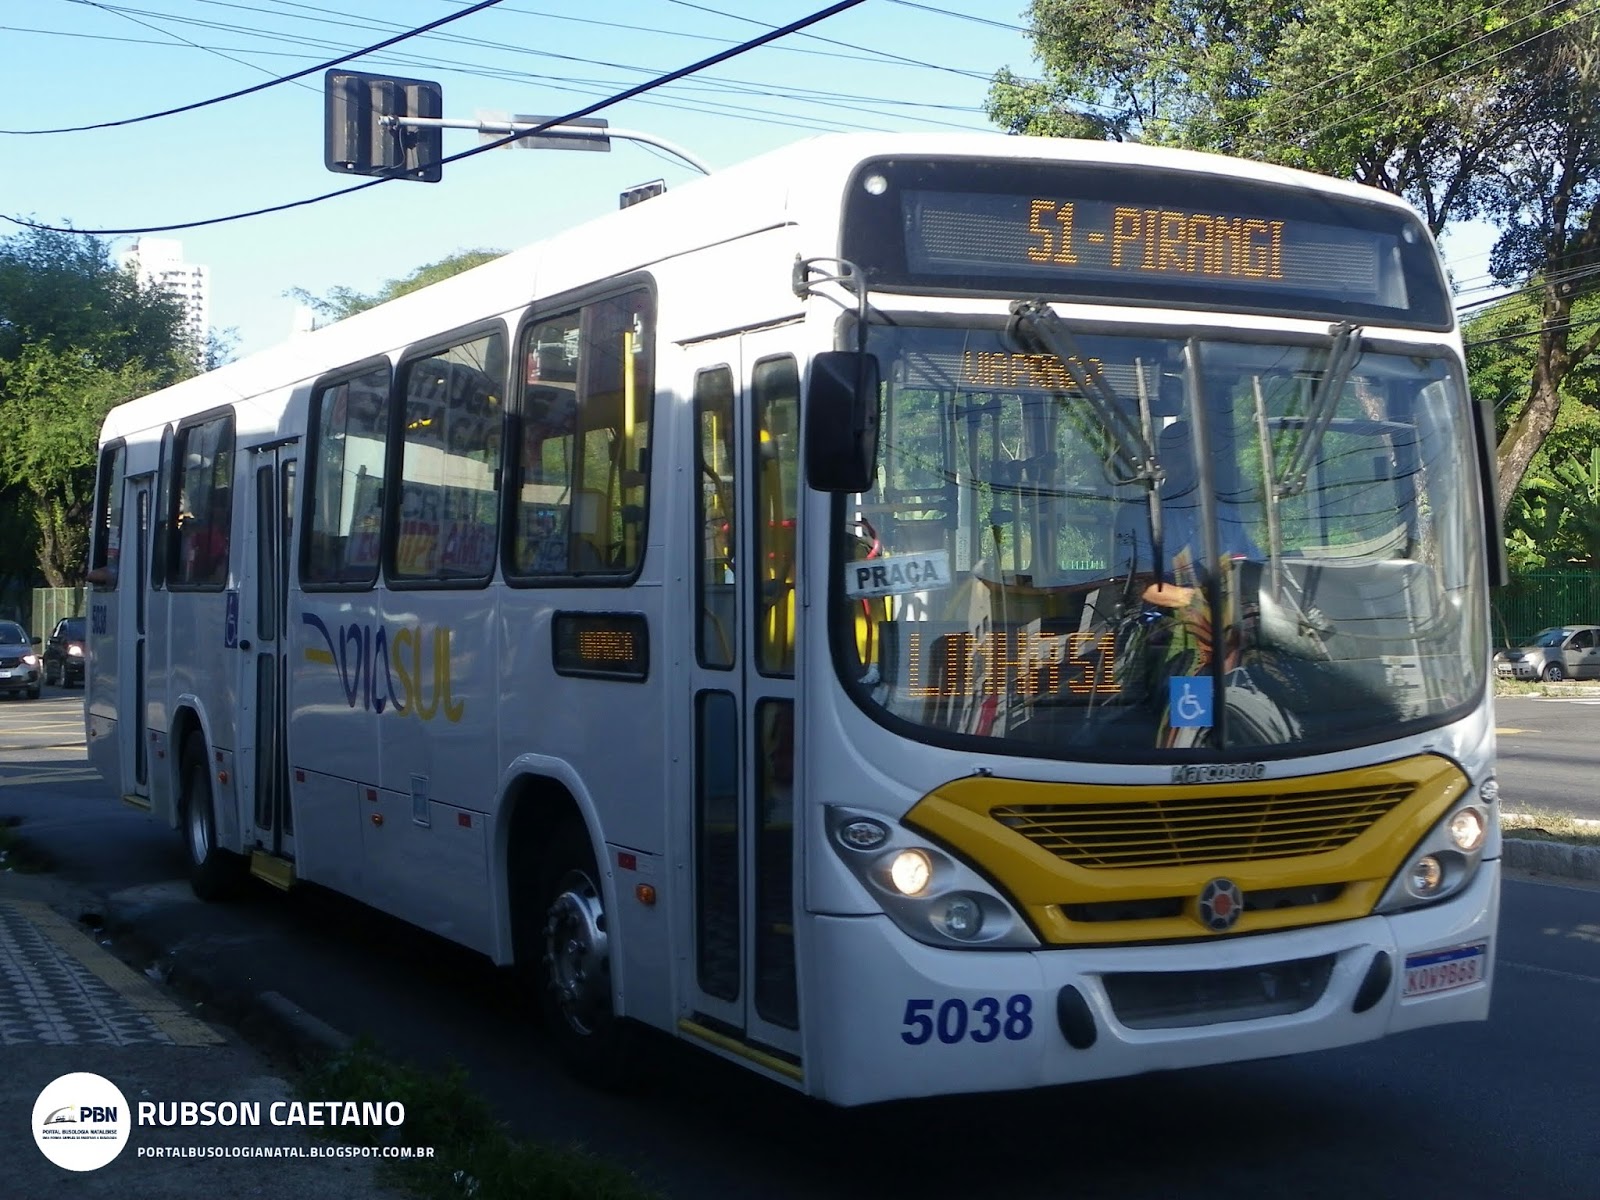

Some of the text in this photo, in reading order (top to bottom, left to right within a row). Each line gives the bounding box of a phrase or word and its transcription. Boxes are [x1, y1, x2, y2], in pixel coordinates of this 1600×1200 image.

[856, 560, 940, 590] PRAÇA
[1068, 632, 1122, 693] 51
[901, 994, 1033, 1045] 5038
